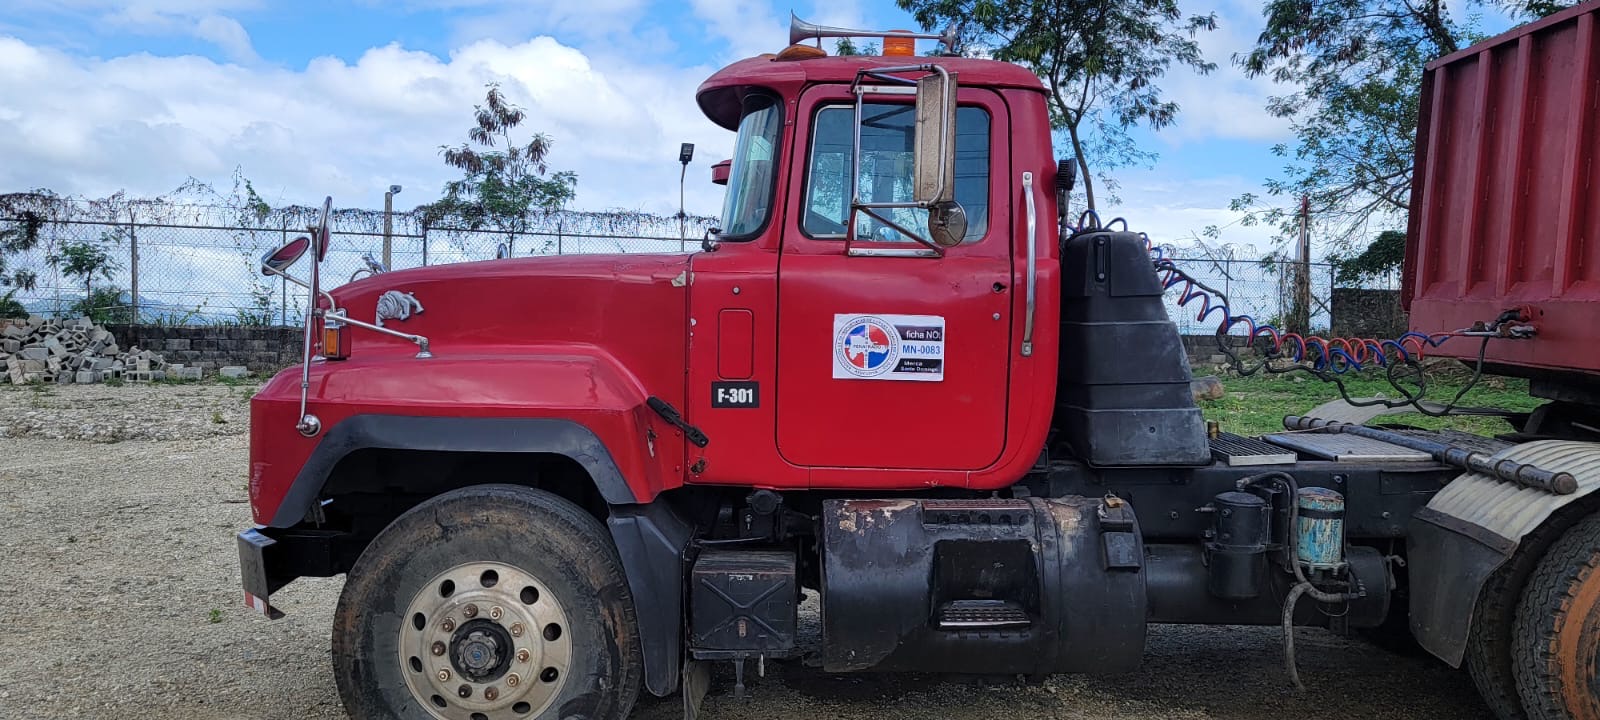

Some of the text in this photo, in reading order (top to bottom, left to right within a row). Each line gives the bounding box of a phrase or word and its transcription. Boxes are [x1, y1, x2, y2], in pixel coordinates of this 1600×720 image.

[906, 329, 925, 339] ficha
[902, 344, 941, 355] MN-0083
[717, 388, 753, 404] F-301
